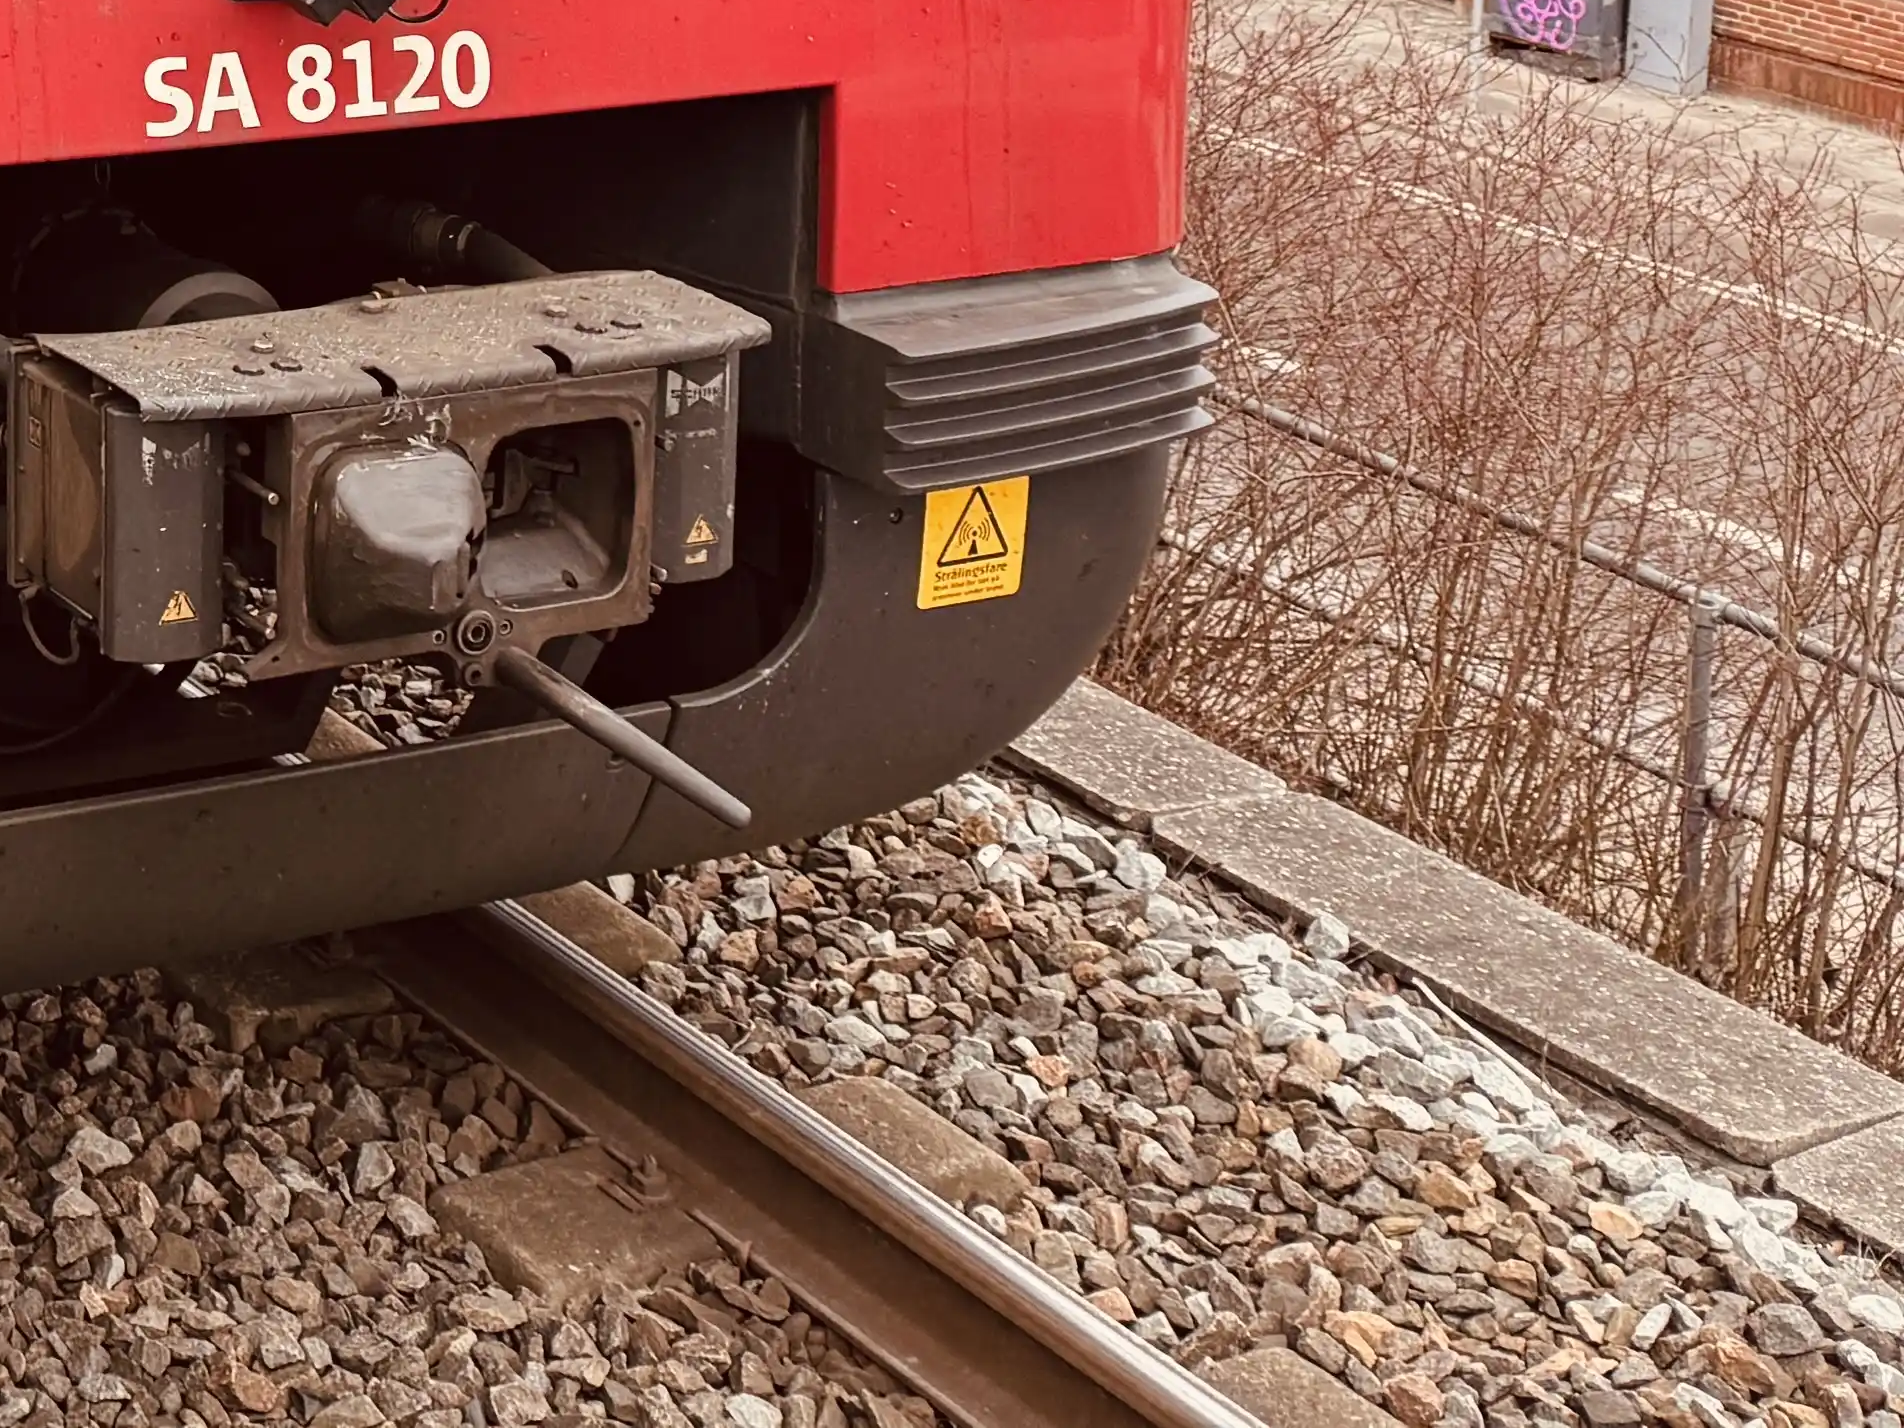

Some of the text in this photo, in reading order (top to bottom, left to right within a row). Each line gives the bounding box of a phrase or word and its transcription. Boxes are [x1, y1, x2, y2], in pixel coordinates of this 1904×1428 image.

[143, 29, 492, 139] SA 8120
[934, 562, 1008, 582] Strålingsfare
